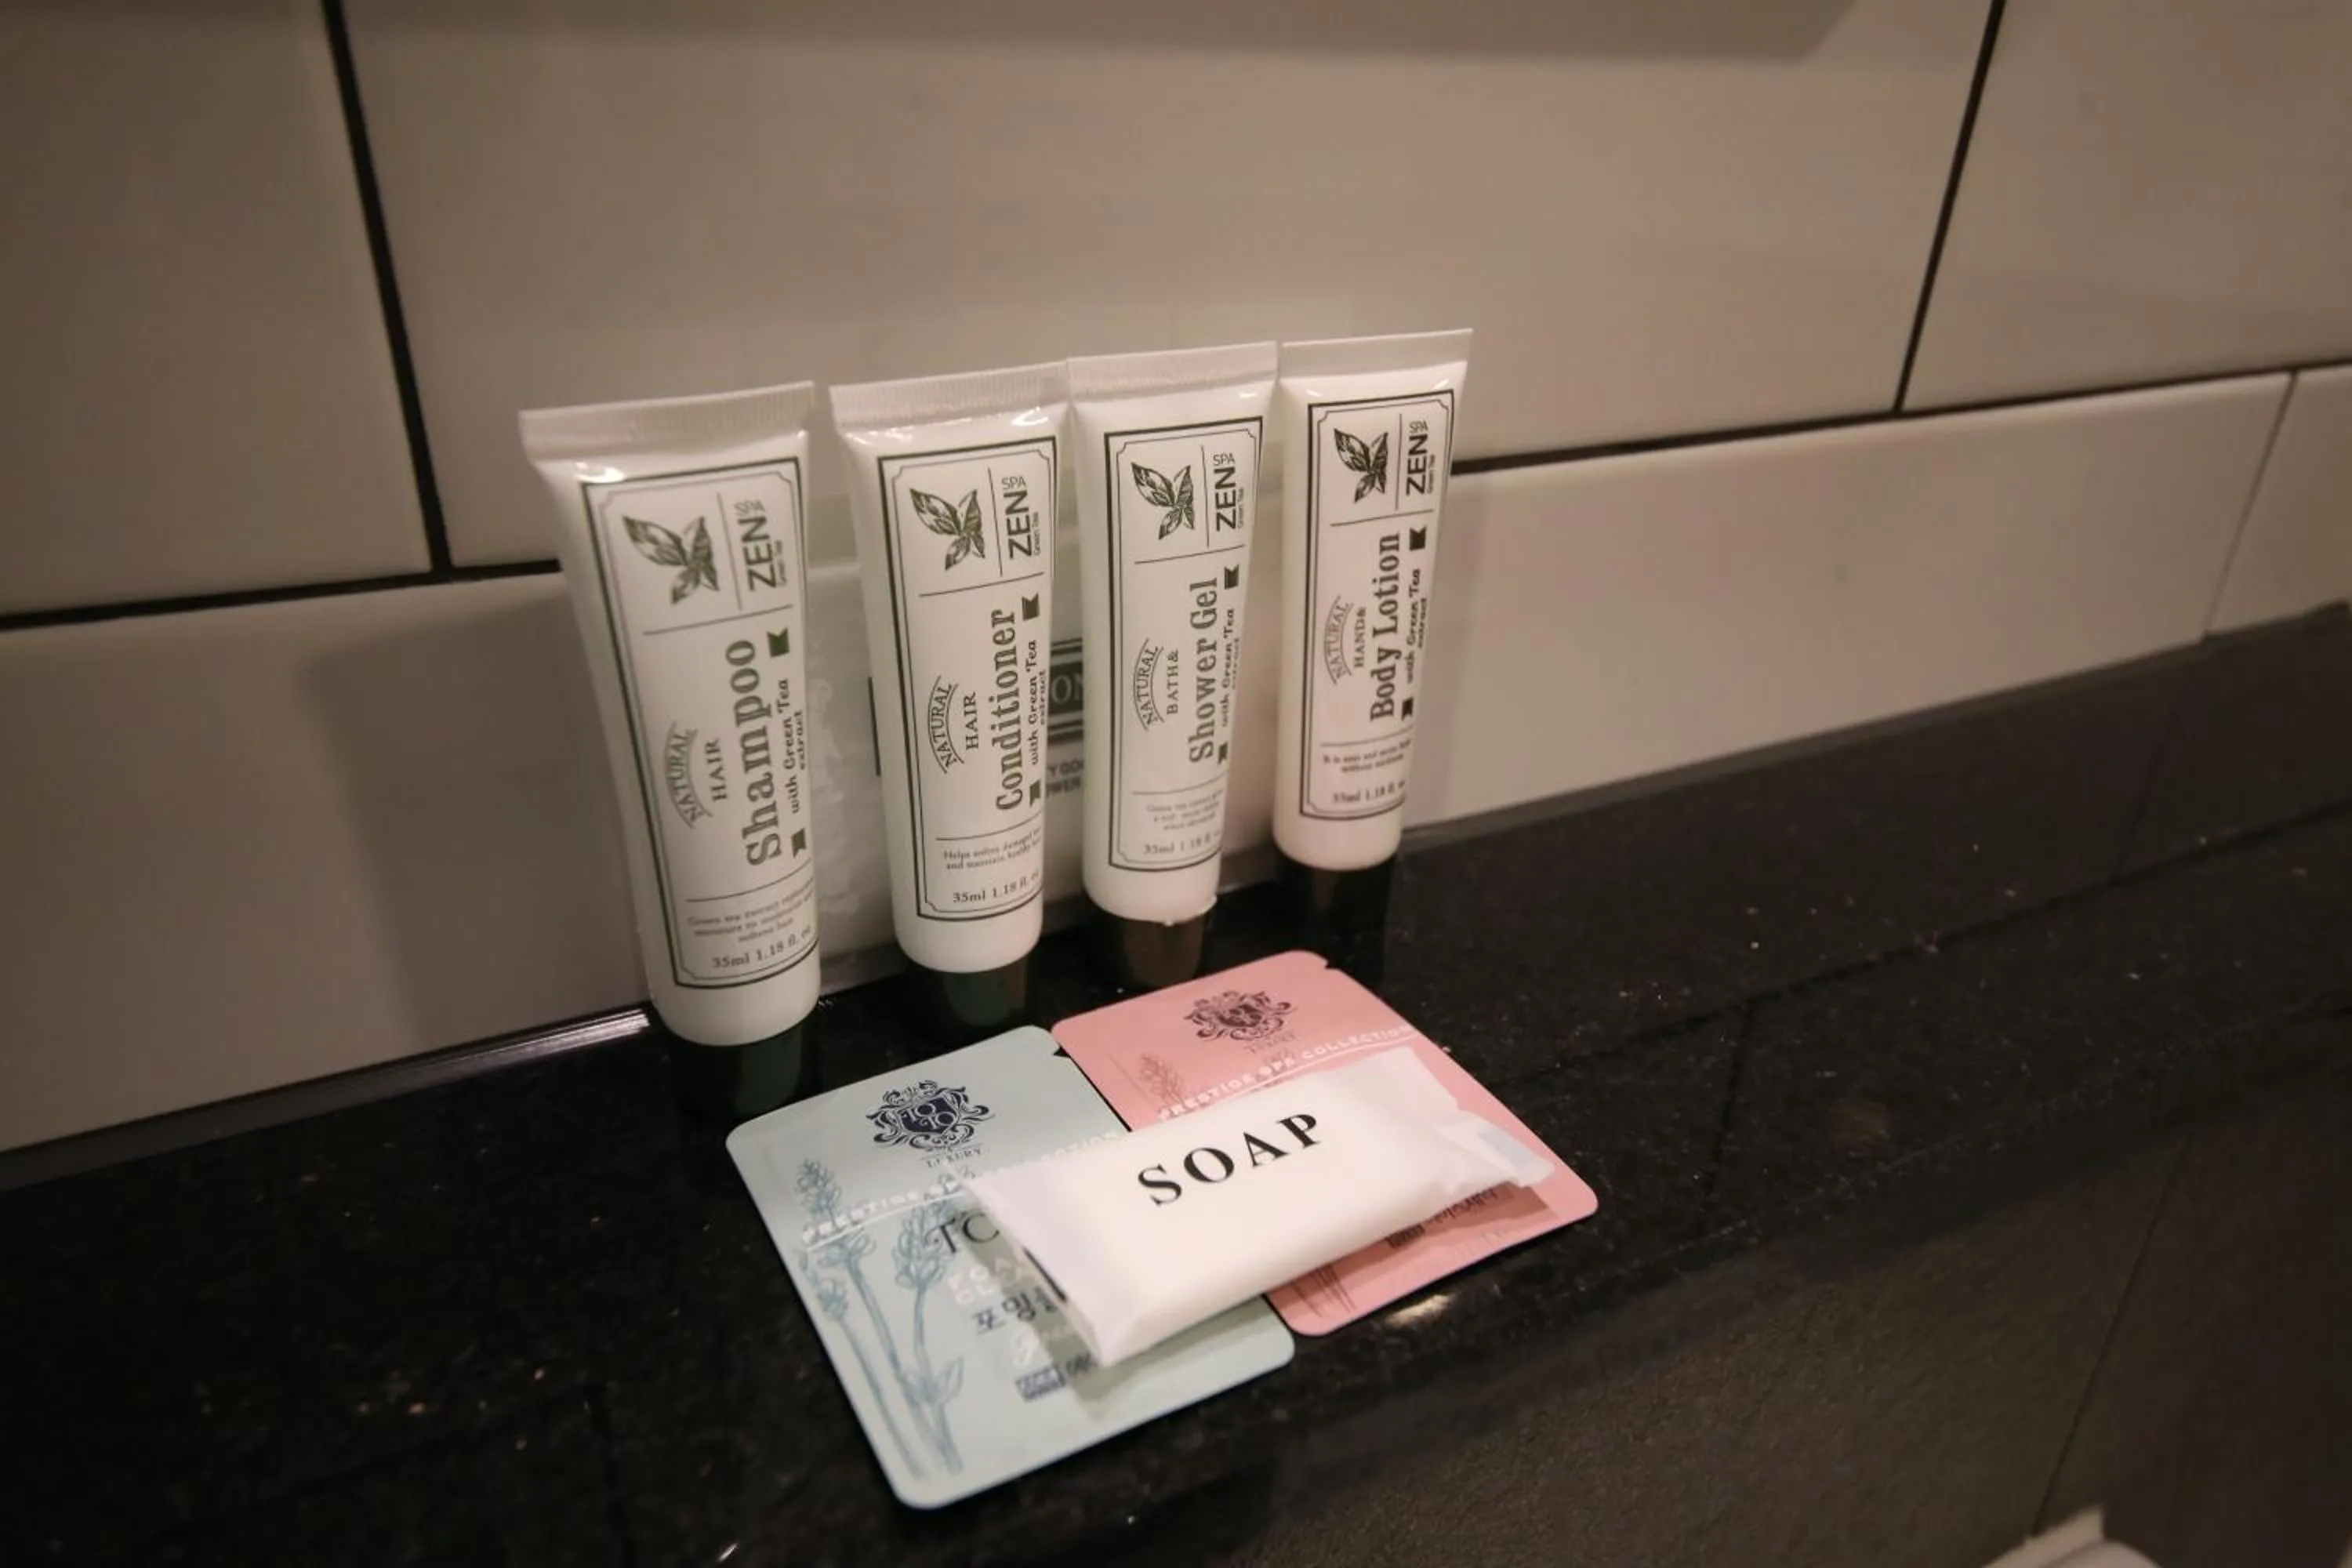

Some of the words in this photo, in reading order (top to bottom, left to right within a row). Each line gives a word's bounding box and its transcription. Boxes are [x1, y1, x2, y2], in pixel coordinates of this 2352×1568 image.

[1001, 476, 1027, 490] SPA
[1213, 452, 1236, 466] SPA
[1406, 434, 1428, 495] ZEN
[1003, 489, 1033, 559] ZEN
[1214, 466, 1236, 532] ZEN
[737, 515, 777, 592] ZEN
[1189, 577, 1218, 630] Gel
[1372, 532, 1399, 638] Lotion
[1409, 568, 1421, 597] Tea
[1223, 608, 1235, 640] Tea
[1326, 602, 1349, 679] NATURAL
[1407, 602, 1418, 646] Green
[1025, 639, 1036, 673] Tea
[1222, 642, 1232, 688] Green
[1405, 651, 1414, 684] with
[776, 678, 790, 714] Tea
[989, 609, 1023, 810] Conditioner
[1028, 674, 1037, 726] Green
[1136, 646, 1159, 724] NATURAL
[1188, 637, 1218, 763] Shower
[1220, 693, 1229, 728] with
[1370, 647, 1402, 721] Body
[782, 717, 797, 770] Green
[793, 710, 806, 771] extract
[931, 683, 959, 769] NATURAL
[964, 691, 979, 750] HAIR
[706, 738, 728, 802] HAIR
[724, 640, 782, 866] Shampoo
[1026, 730, 1038, 766] with
[669, 729, 703, 822] NATURAL
[785, 774, 800, 815] with
[953, 890, 985, 903] 35ml
[992, 880, 1018, 899] 1.18
[710, 953, 750, 969] 35ml
[756, 941, 785, 962] 1.18
[1260, 1057, 1296, 1077] SPA
[1301, 1024, 1414, 1059] COLLECTION
[1138, 1113, 1321, 1207] SOAP
